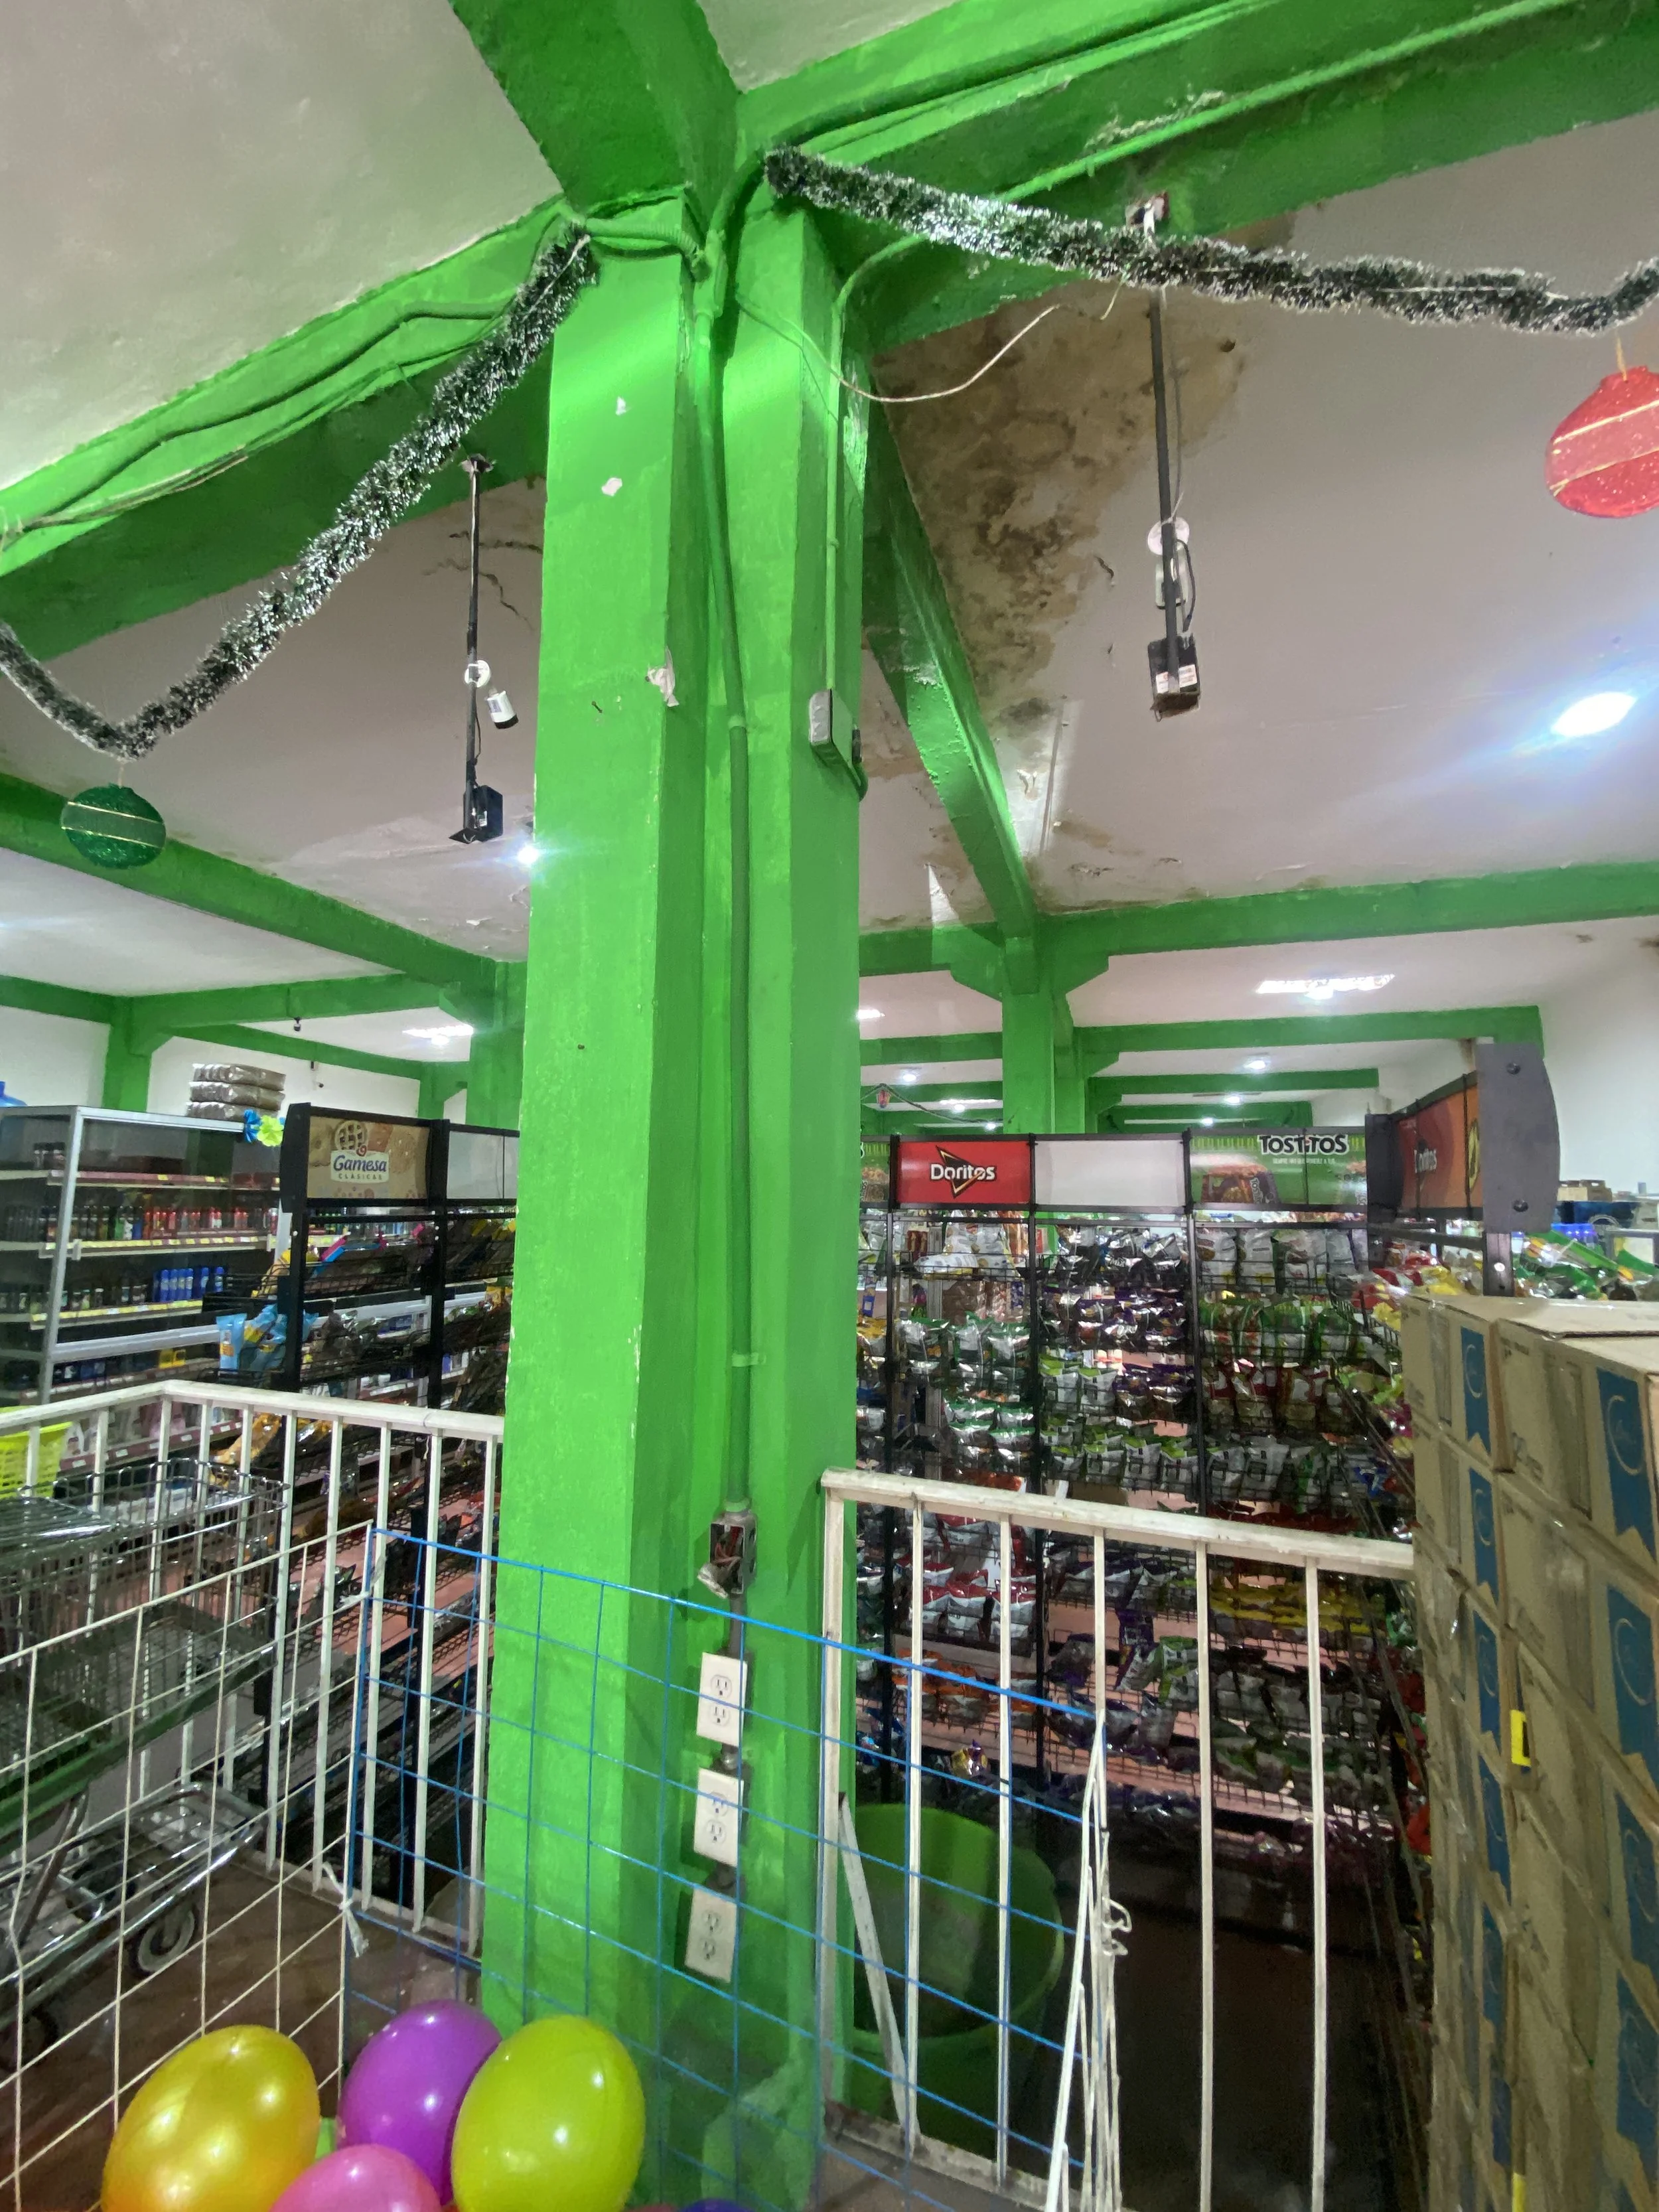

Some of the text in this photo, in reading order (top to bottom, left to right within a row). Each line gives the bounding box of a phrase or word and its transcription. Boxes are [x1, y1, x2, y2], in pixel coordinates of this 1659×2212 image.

[1258, 1134, 1348, 1154] TOSTITOS
[333, 1155, 386, 1172] Gamesa
[930, 1163, 996, 1181] Doritos
